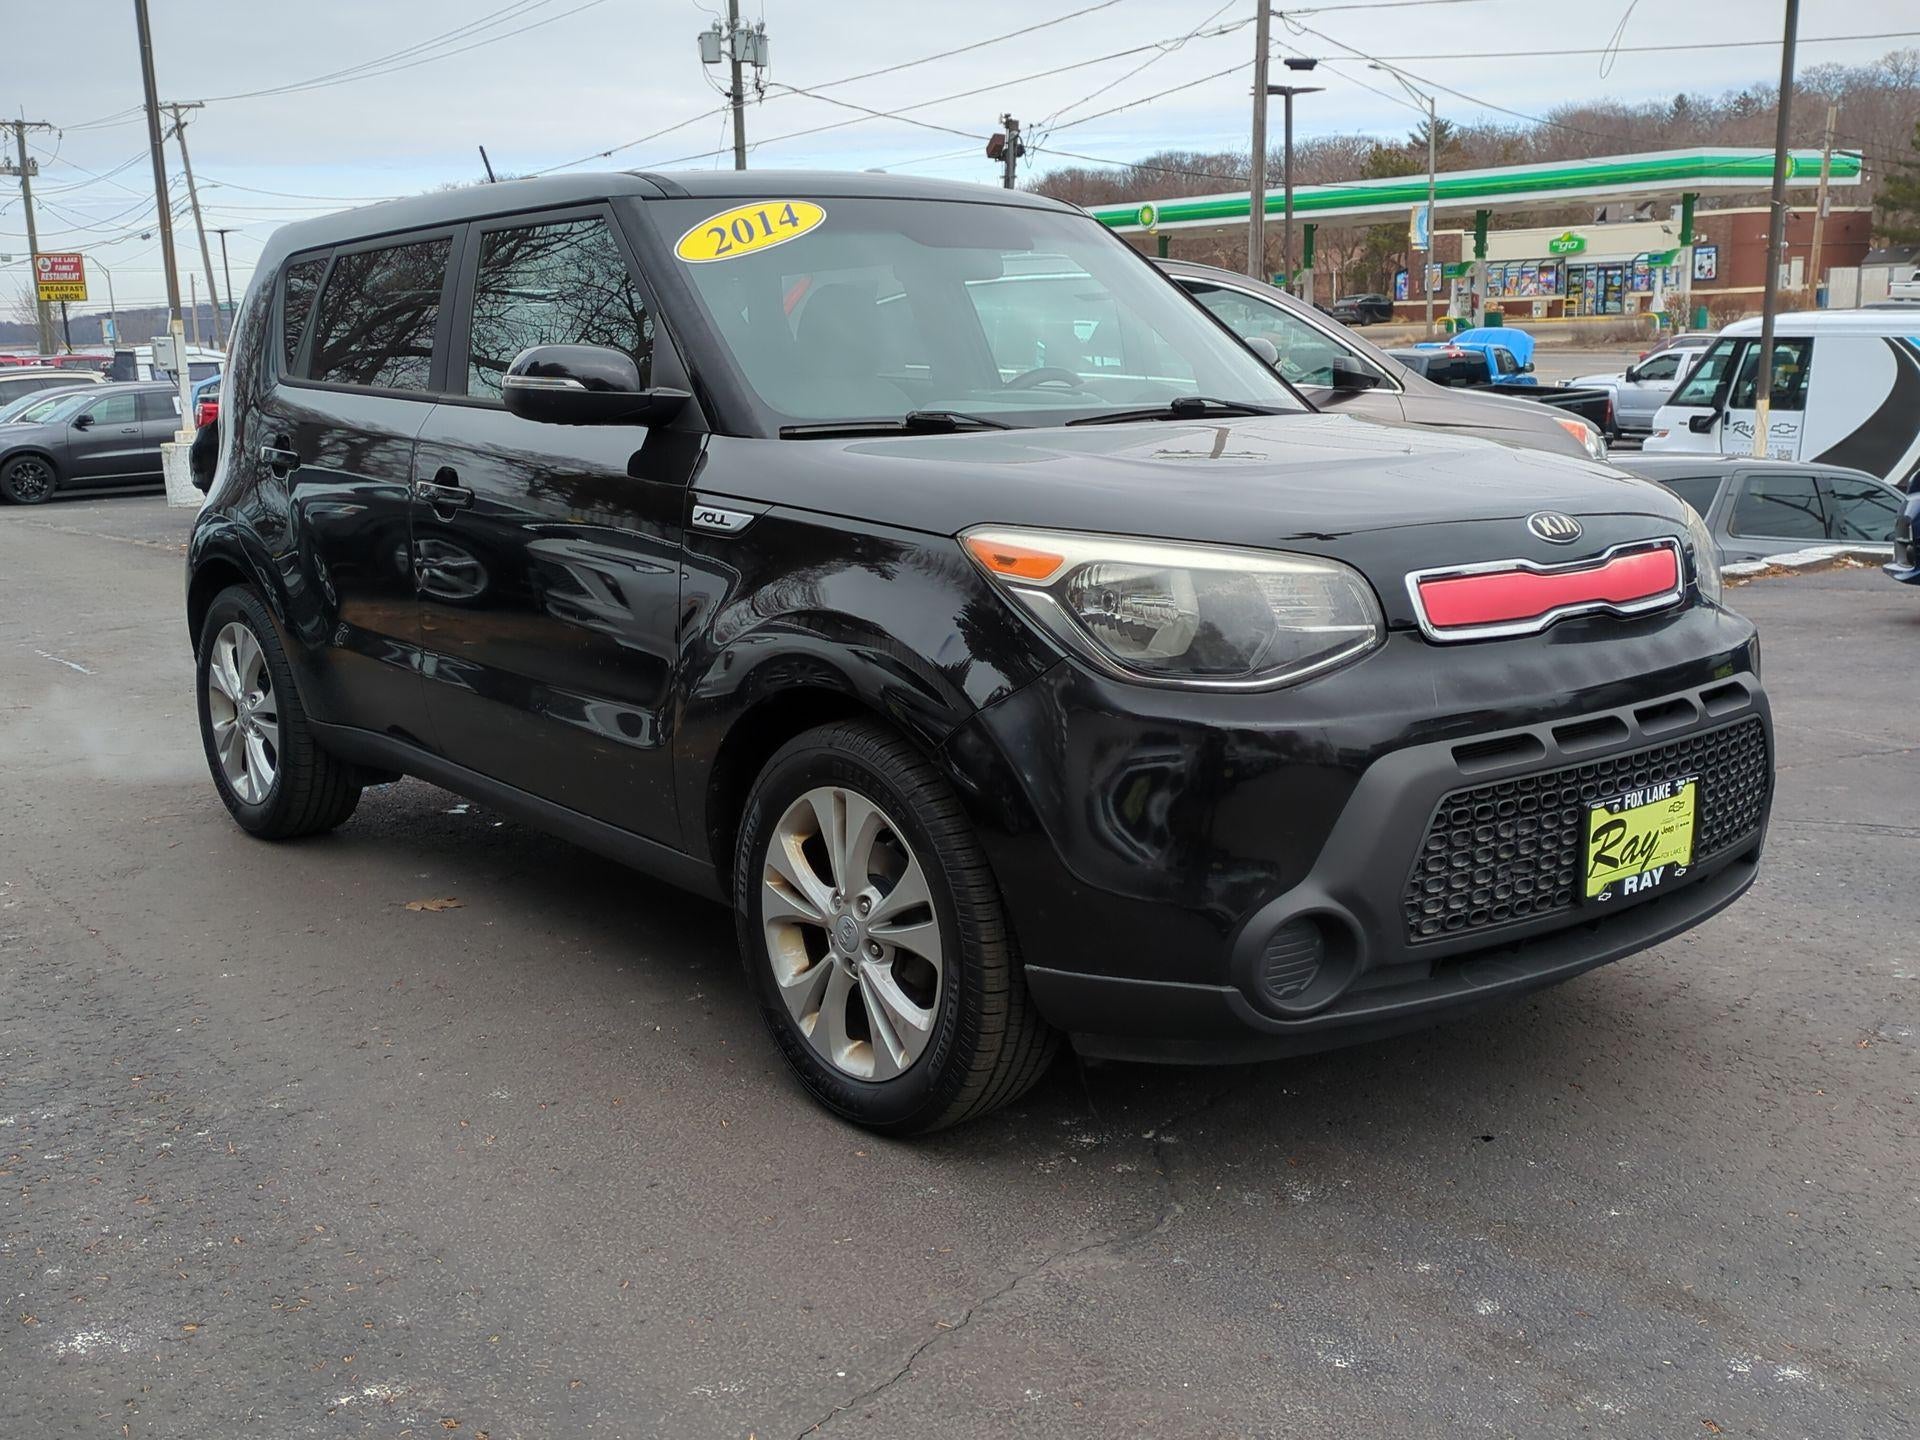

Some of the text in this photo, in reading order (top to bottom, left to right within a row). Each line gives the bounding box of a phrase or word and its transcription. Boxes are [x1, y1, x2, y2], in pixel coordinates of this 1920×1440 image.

[707, 203, 799, 256] 2014
[41, 272, 80, 281] RESTAURANT
[1534, 515, 1578, 536] KIA
[1624, 790, 1644, 810] FOX
[1646, 782, 1671, 804] LAKE
[1587, 818, 1659, 878] Ray
[1624, 866, 1664, 896] RAY
